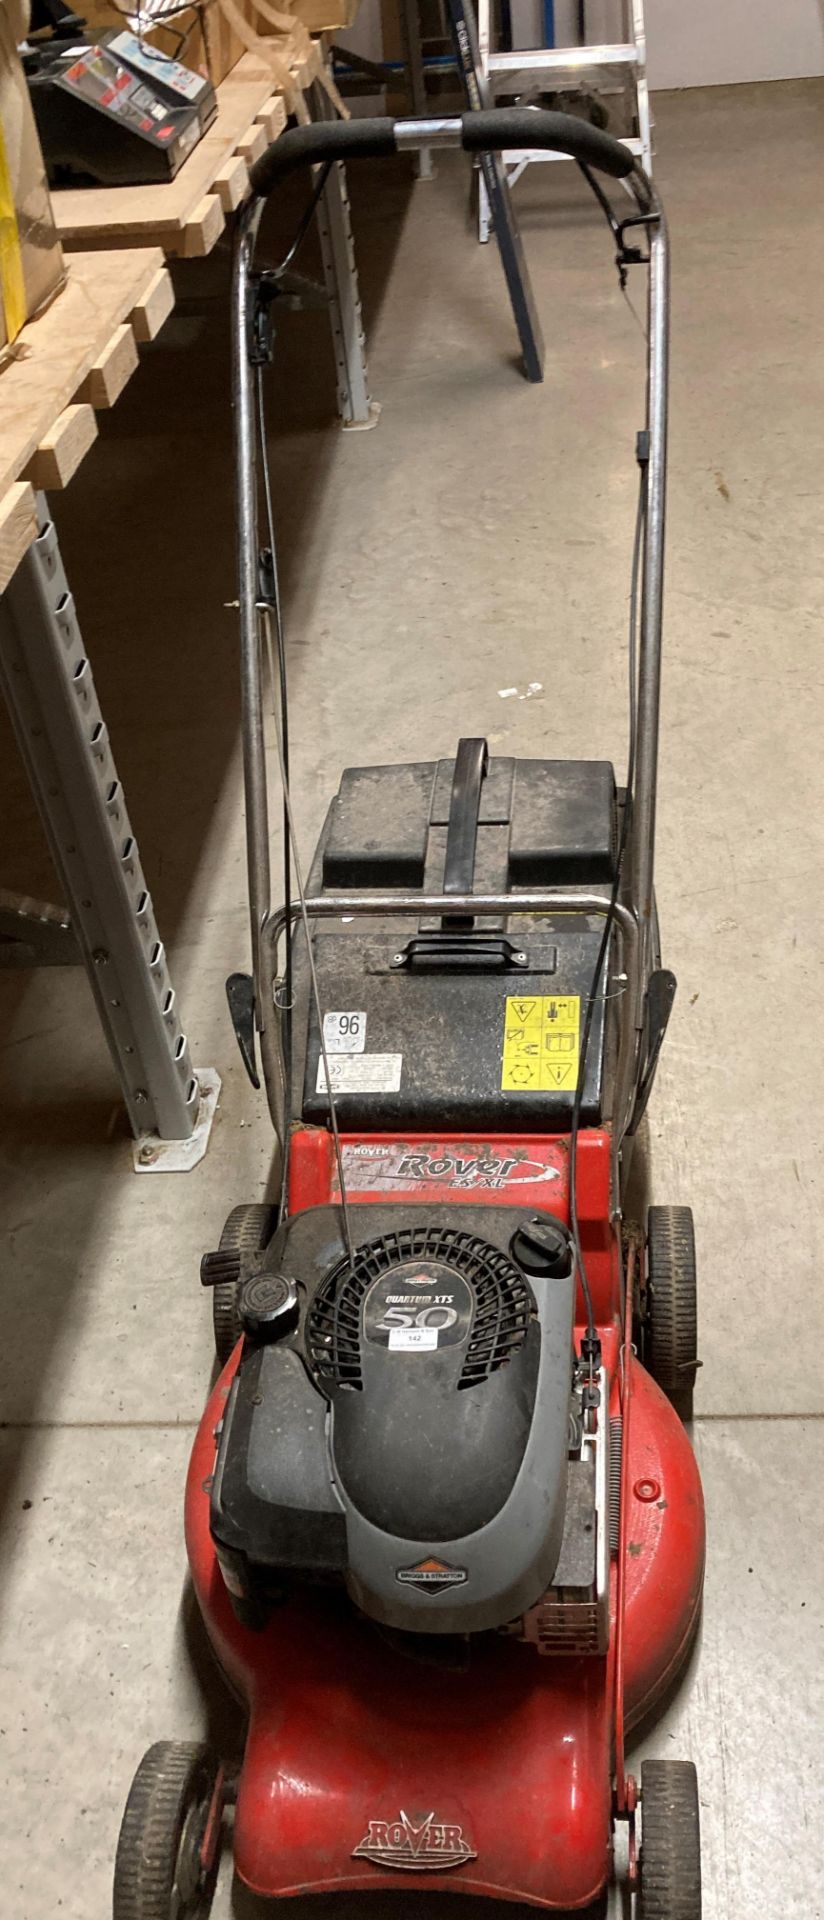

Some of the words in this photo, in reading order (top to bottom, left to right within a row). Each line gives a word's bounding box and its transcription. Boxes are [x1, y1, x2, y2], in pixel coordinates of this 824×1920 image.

[339, 1015, 360, 1035] 96
[398, 1154, 518, 1178] Rover
[385, 1295, 432, 1304] QUANTUM
[433, 1295, 455, 1304] XTS
[375, 1306, 458, 1330] 50
[367, 1810, 463, 1858] ROVER
